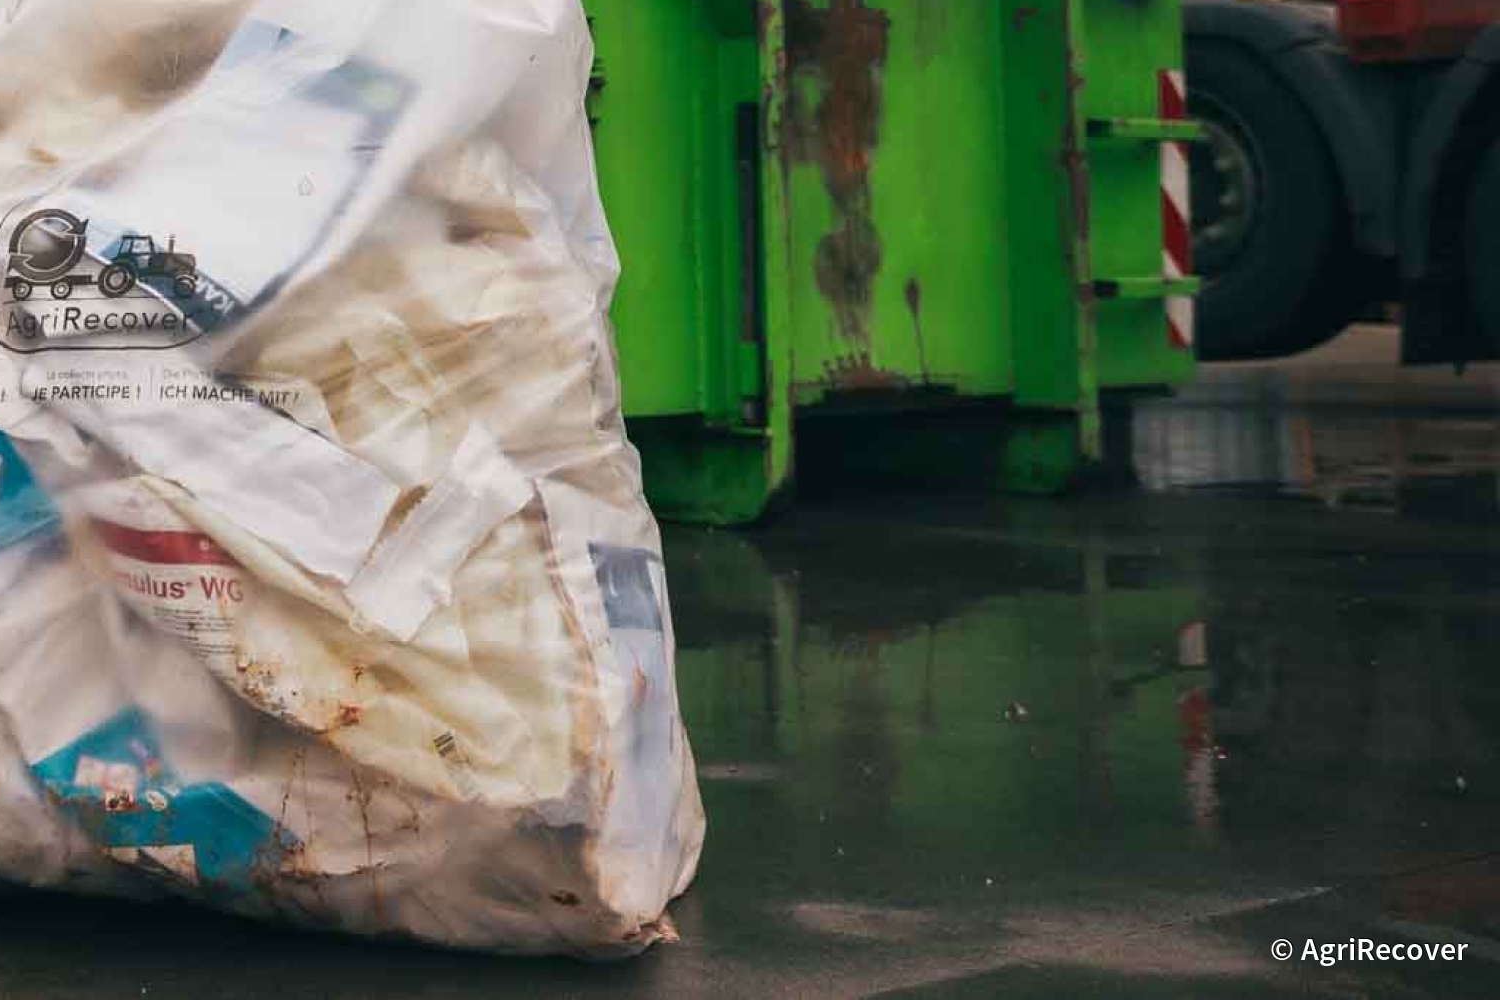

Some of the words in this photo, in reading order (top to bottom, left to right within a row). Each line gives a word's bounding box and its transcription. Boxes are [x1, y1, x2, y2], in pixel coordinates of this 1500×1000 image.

[5, 306, 190, 339] AgriRecover
[33, 387, 48, 402] JE
[52, 385, 130, 401] PARTICIPE
[159, 385, 187, 400] ICH
[192, 386, 255, 403] MACHE
[258, 390, 292, 406] MIT
[201, 575, 244, 602] WG
